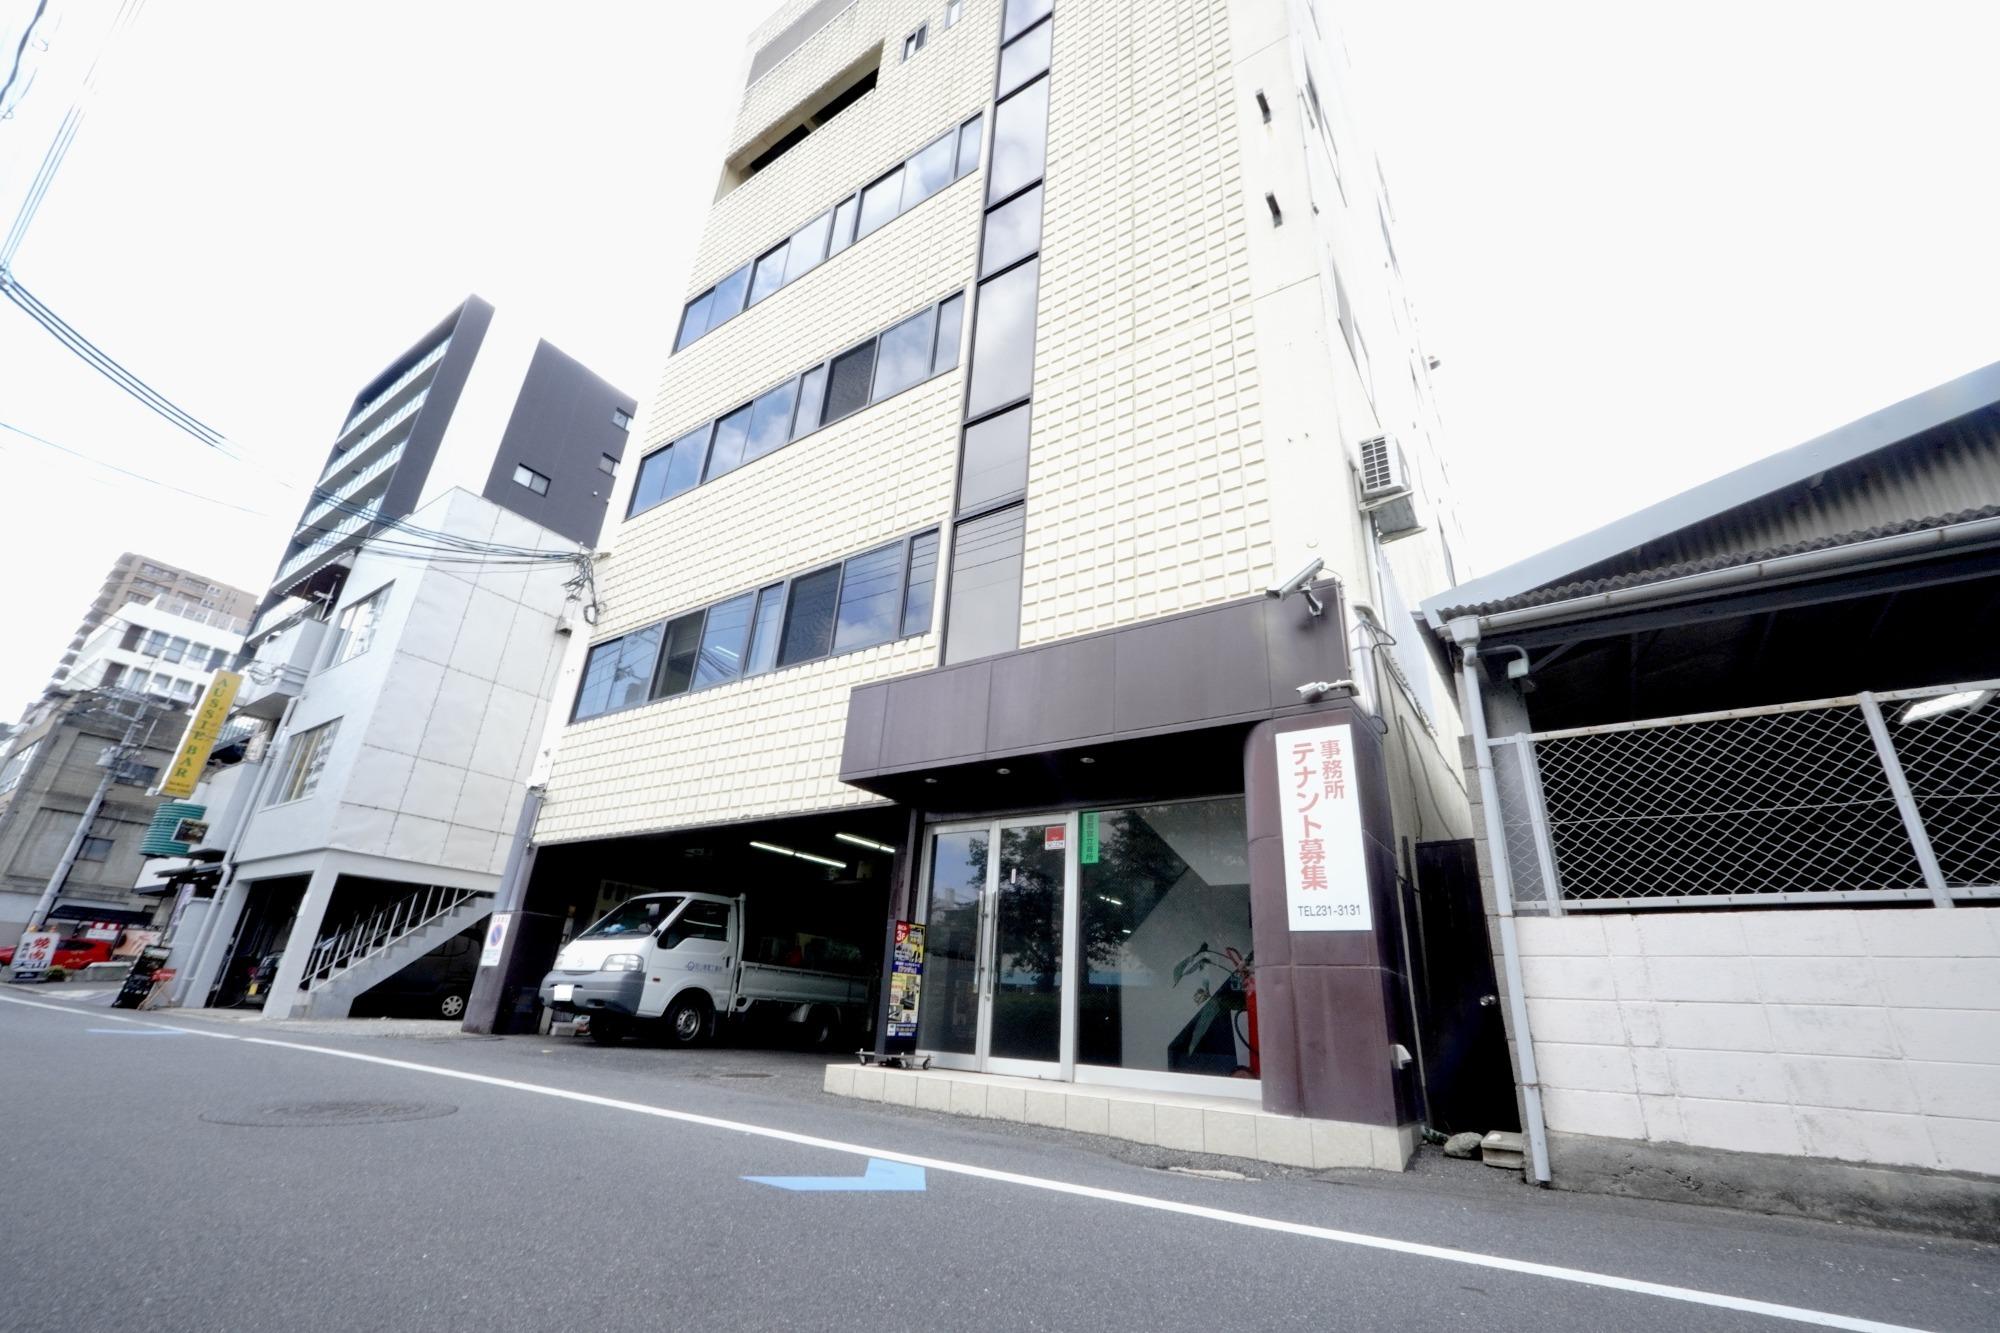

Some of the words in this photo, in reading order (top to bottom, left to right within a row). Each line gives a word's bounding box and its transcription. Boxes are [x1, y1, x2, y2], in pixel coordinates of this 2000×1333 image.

[192, 678, 228, 740] AUSSIE
[174, 744, 198, 778] BAR
[1320, 739, 1345, 800] 事務所
[1292, 742, 1328, 890] テナント募集
[30, 937, 50, 960] 焼肉
